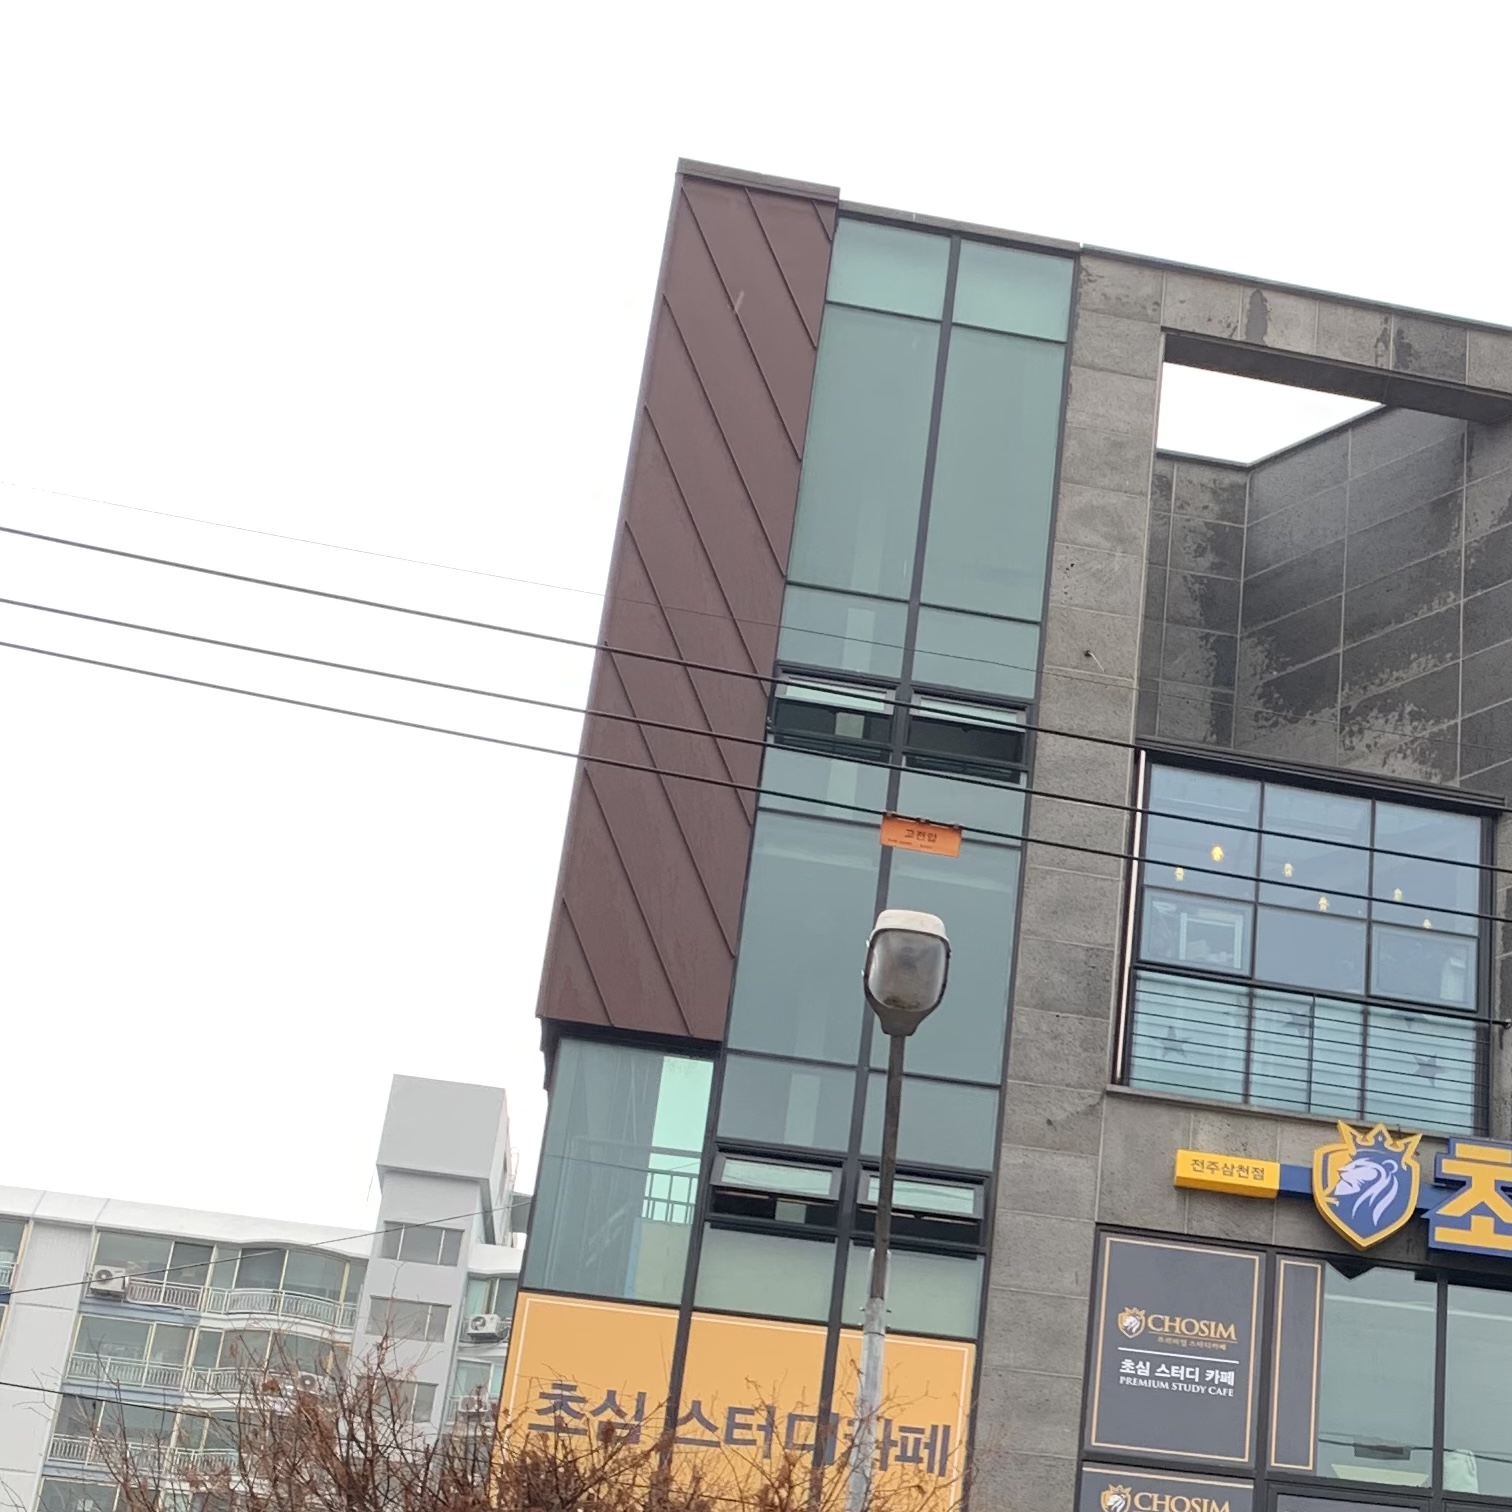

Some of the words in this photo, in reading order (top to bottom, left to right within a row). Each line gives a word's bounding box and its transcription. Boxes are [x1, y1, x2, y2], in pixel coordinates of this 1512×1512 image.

[904, 828, 938, 843] 고전압
[1191, 1159, 1265, 1181] 전주삼천점
[1147, 1314, 1238, 1341] CHOSIM
[1119, 1358, 1151, 1377] 초심
[1154, 1363, 1200, 1383] 스터디
[1204, 1369, 1235, 1387] 카페
[1119, 1376, 1170, 1390] PREMIUM
[1171, 1382, 1207, 1394] STUDY
[1208, 1386, 1235, 1397] CAFE
[527, 1381, 647, 1446] 초심
